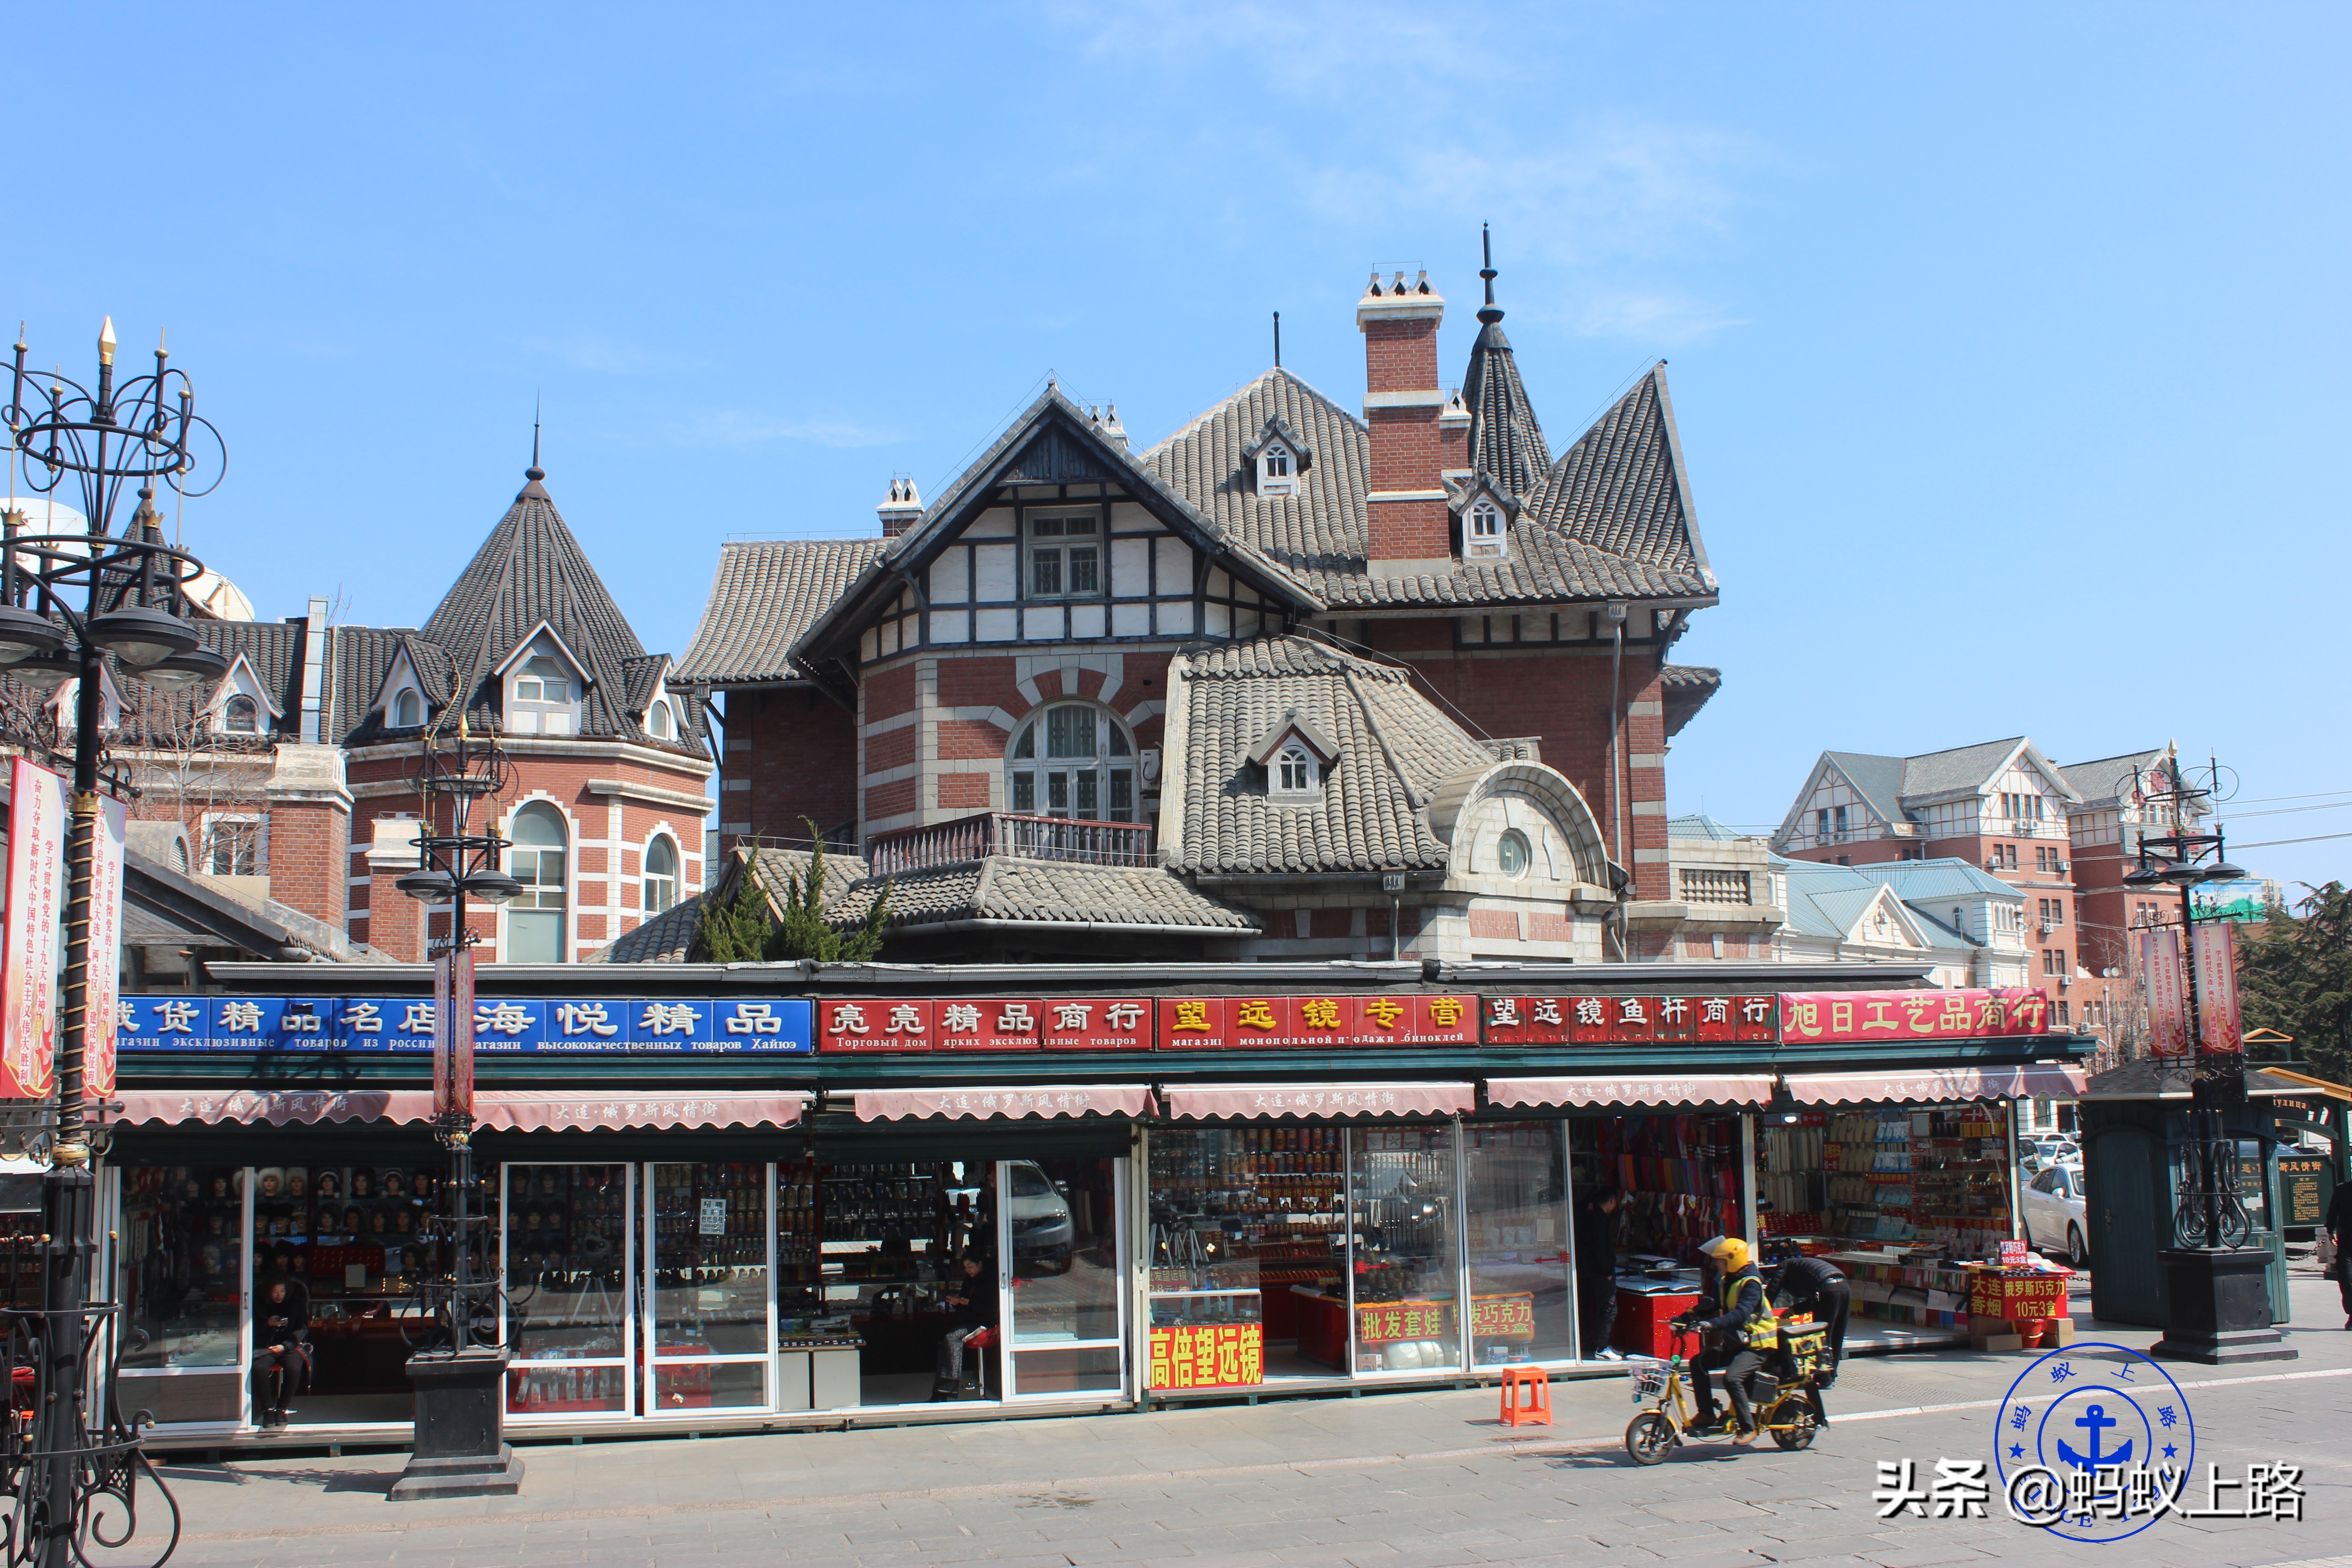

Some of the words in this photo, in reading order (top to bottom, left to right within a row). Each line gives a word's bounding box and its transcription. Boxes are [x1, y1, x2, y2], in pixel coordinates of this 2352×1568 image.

[19, 778, 42, 1085] 奋力夺取新时代中国特色社会主义伟大胜利
[37, 840, 54, 1014] 学习贯彻党的十九大精神
[102, 861, 115, 1020] 学习贯彻党的十九大精神
[473, 1002, 782, 1036] 海悦精品
[829, 1003, 1145, 1034] 亮亮精品商行
[1172, 998, 1463, 1031] 望远镜专营
[1491, 997, 1769, 1027] 望远镜鱼杆商行
[1784, 995, 2045, 1036] 旭日工艺品商行
[173, 1037, 275, 1047] эксклюзивные
[295, 1038, 347, 1051] товаров
[363, 1038, 378, 1047] из
[537, 1039, 682, 1050] высококачественных
[691, 1039, 742, 1054] товаров
[751, 1039, 797, 1049] Хайюэ
[836, 1037, 898, 1049] Торговый
[905, 1038, 927, 1048] дом
[943, 1038, 980, 1048] ярких
[1090, 1037, 1137, 1047] товаров
[1240, 1035, 1332, 1045] монопольной
[1338, 1034, 1394, 1044] подажи
[1403, 1032, 1464, 1042] биноклей
[1263, 1188, 1333, 1197] 俄罗斯传统套娃
[1971, 1276, 2002, 1297] 大连
[2004, 1279, 2065, 1297] 俄罗斯巧克力
[1971, 1296, 2002, 1317] 香烟
[2015, 1301, 2056, 1318] 10元3盒
[1363, 1309, 1442, 1340] 批发套娃
[1150, 1324, 1261, 1388] 高倍望远镜
